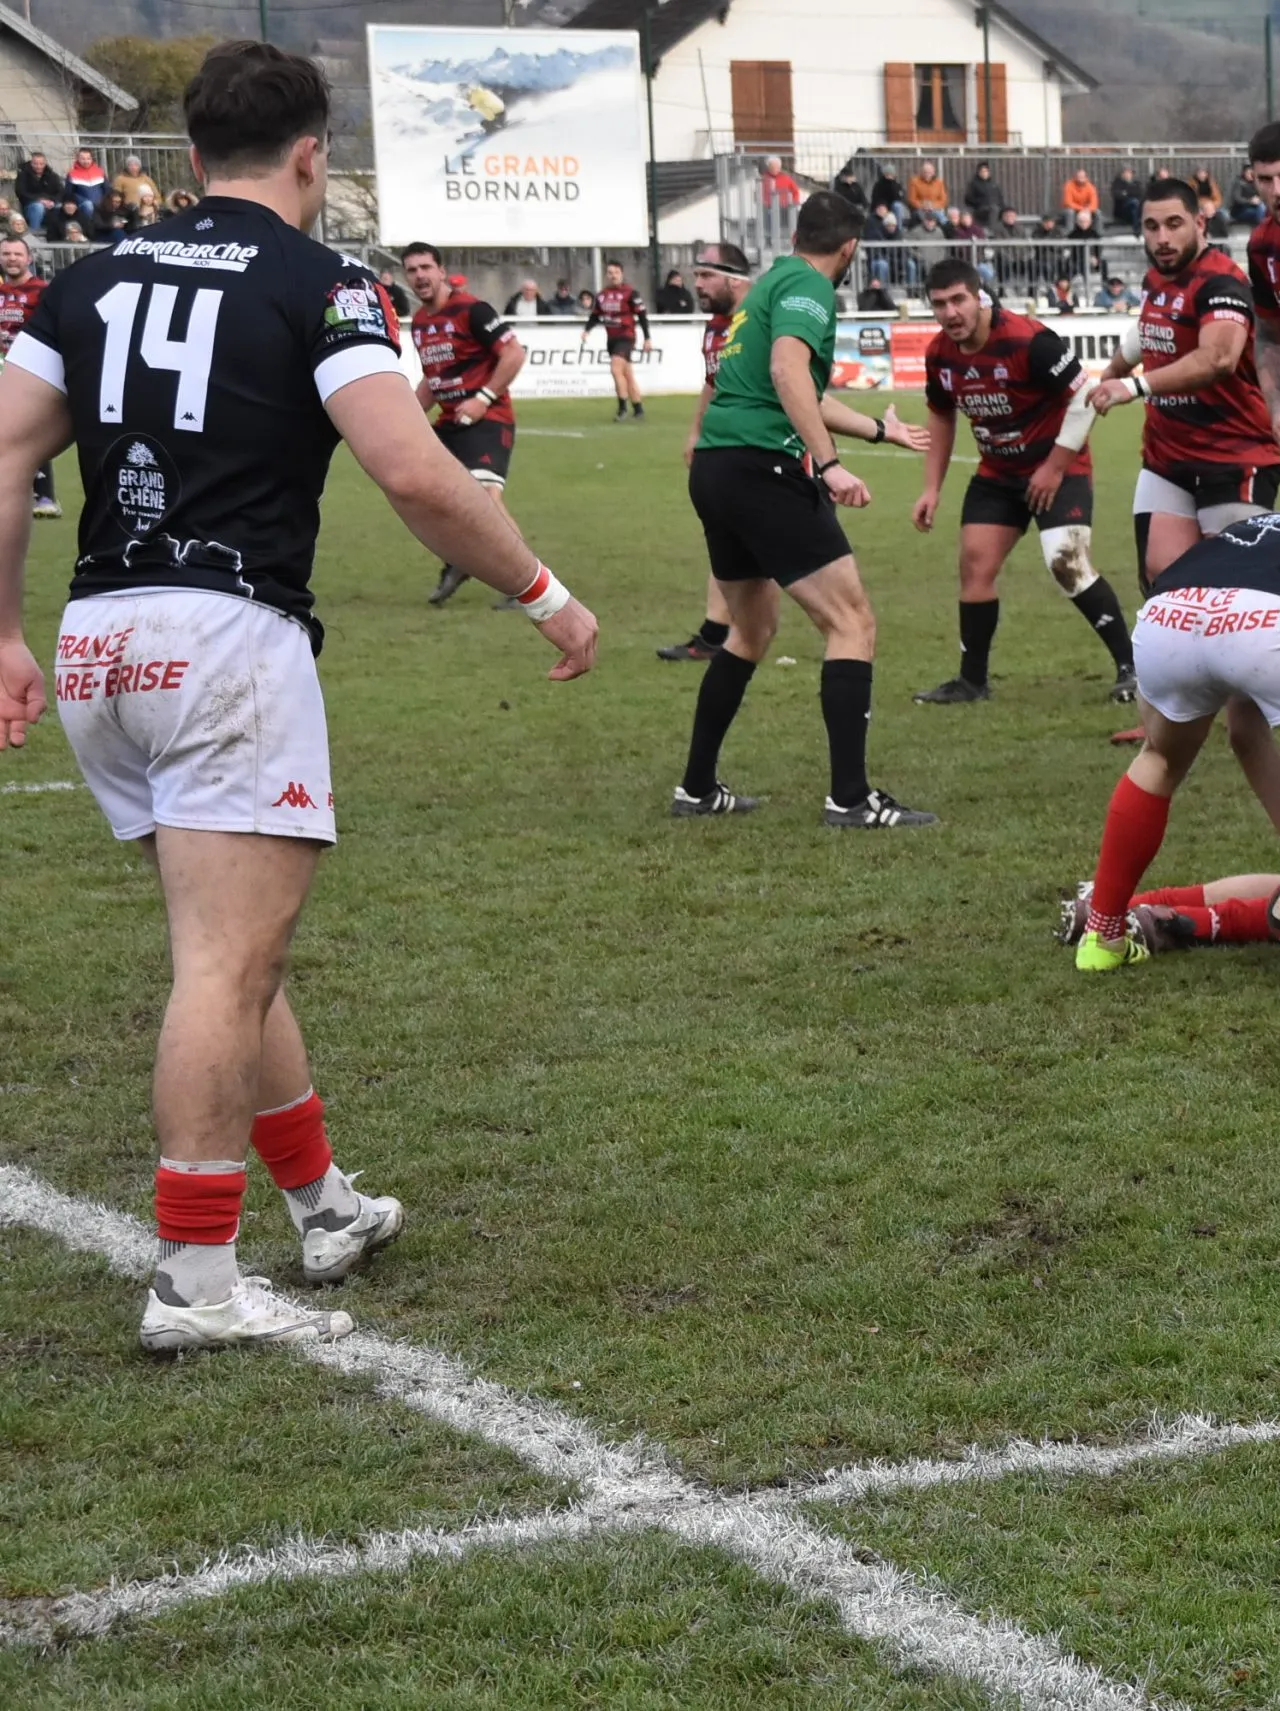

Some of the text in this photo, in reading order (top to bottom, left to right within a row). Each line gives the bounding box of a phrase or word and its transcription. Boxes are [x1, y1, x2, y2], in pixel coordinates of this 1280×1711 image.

[444, 154, 580, 177] LE GRAND
[446, 180, 580, 201] BORNAND
[1145, 323, 1174, 340] GRAND
[95, 281, 224, 432] 14
[523, 342, 662, 365] orcheon
[1140, 337, 1176, 354] ORNAND
[119, 468, 164, 489] GRAND
[118, 486, 165, 510] CHÊNE
[1166, 587, 1240, 607] RANCE
[58, 627, 135, 659] FRANCE
[56, 661, 190, 701] ARE-BRISE
